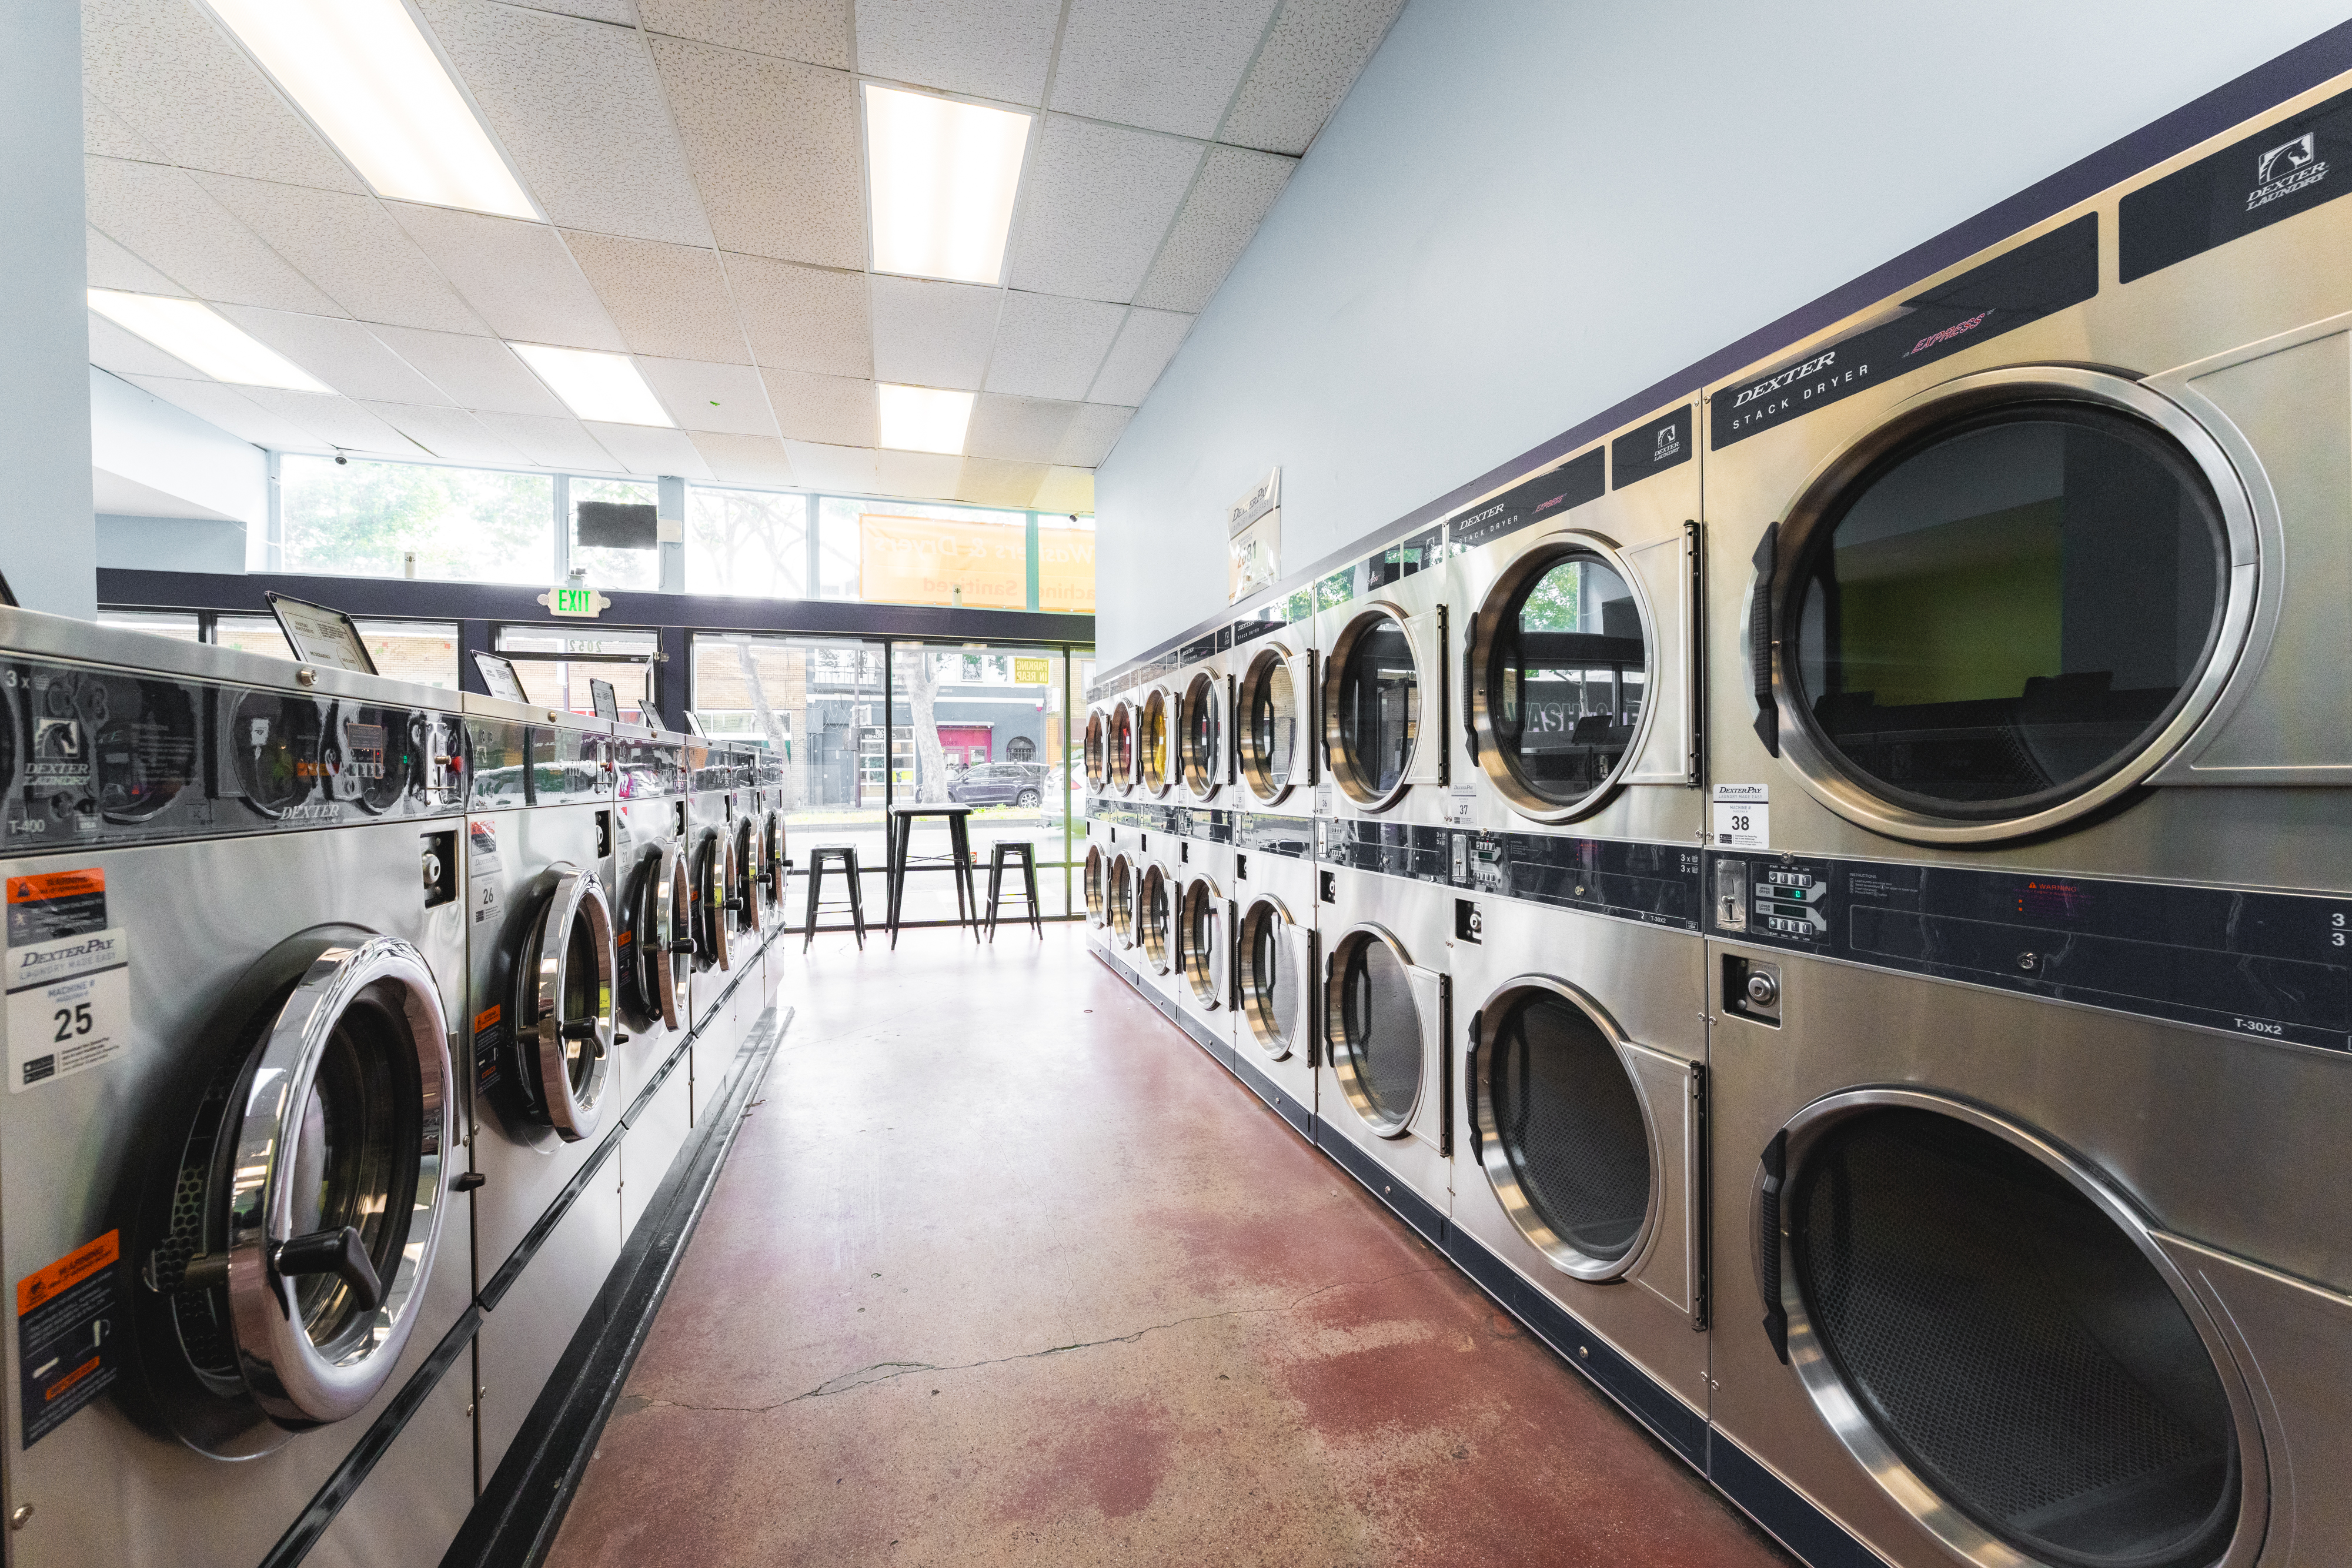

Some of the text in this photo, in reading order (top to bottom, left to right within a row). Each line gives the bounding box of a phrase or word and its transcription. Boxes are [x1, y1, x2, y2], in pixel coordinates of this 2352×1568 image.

[2246, 161, 2328, 202] DEXTER
[2246, 170, 2329, 211] LAUNDRY
[1733, 313, 1985, 409] DEXTER EXPRESS
[1733, 364, 1869, 430] STACK DRYER
[1654, 442, 1679, 457] DEXTER
[1654, 446, 1680, 462] LAUNDRY
[1459, 494, 1563, 531] DEXTER EXPRESS
[1459, 515, 1518, 544] STACK DRYER
[559, 590, 590, 612] EXIT
[1238, 620, 1254, 631] DEXTER
[5, 670, 17, 687] 3
[25, 763, 89, 774] DEXTER
[1322, 799, 1327, 807] 36
[1459, 804, 1468, 815] 37
[279, 804, 339, 821] DEXTER
[8, 820, 45, 834] T-400
[1732, 815, 1749, 831] 38
[1681, 854, 1685, 862] 3
[483, 887, 494, 905] 26
[2039, 884, 2077, 892] WARNING
[1651, 915, 1666, 924] T-30X2
[2331, 913, 2345, 927] 3
[2331, 932, 2345, 946] 3
[68, 957, 92, 969] MADE
[95, 952, 116, 962] EASY
[48, 981, 86, 998] MACHINE
[55, 1002, 92, 1042] 25
[2234, 1018, 2282, 1035] T-30X2
